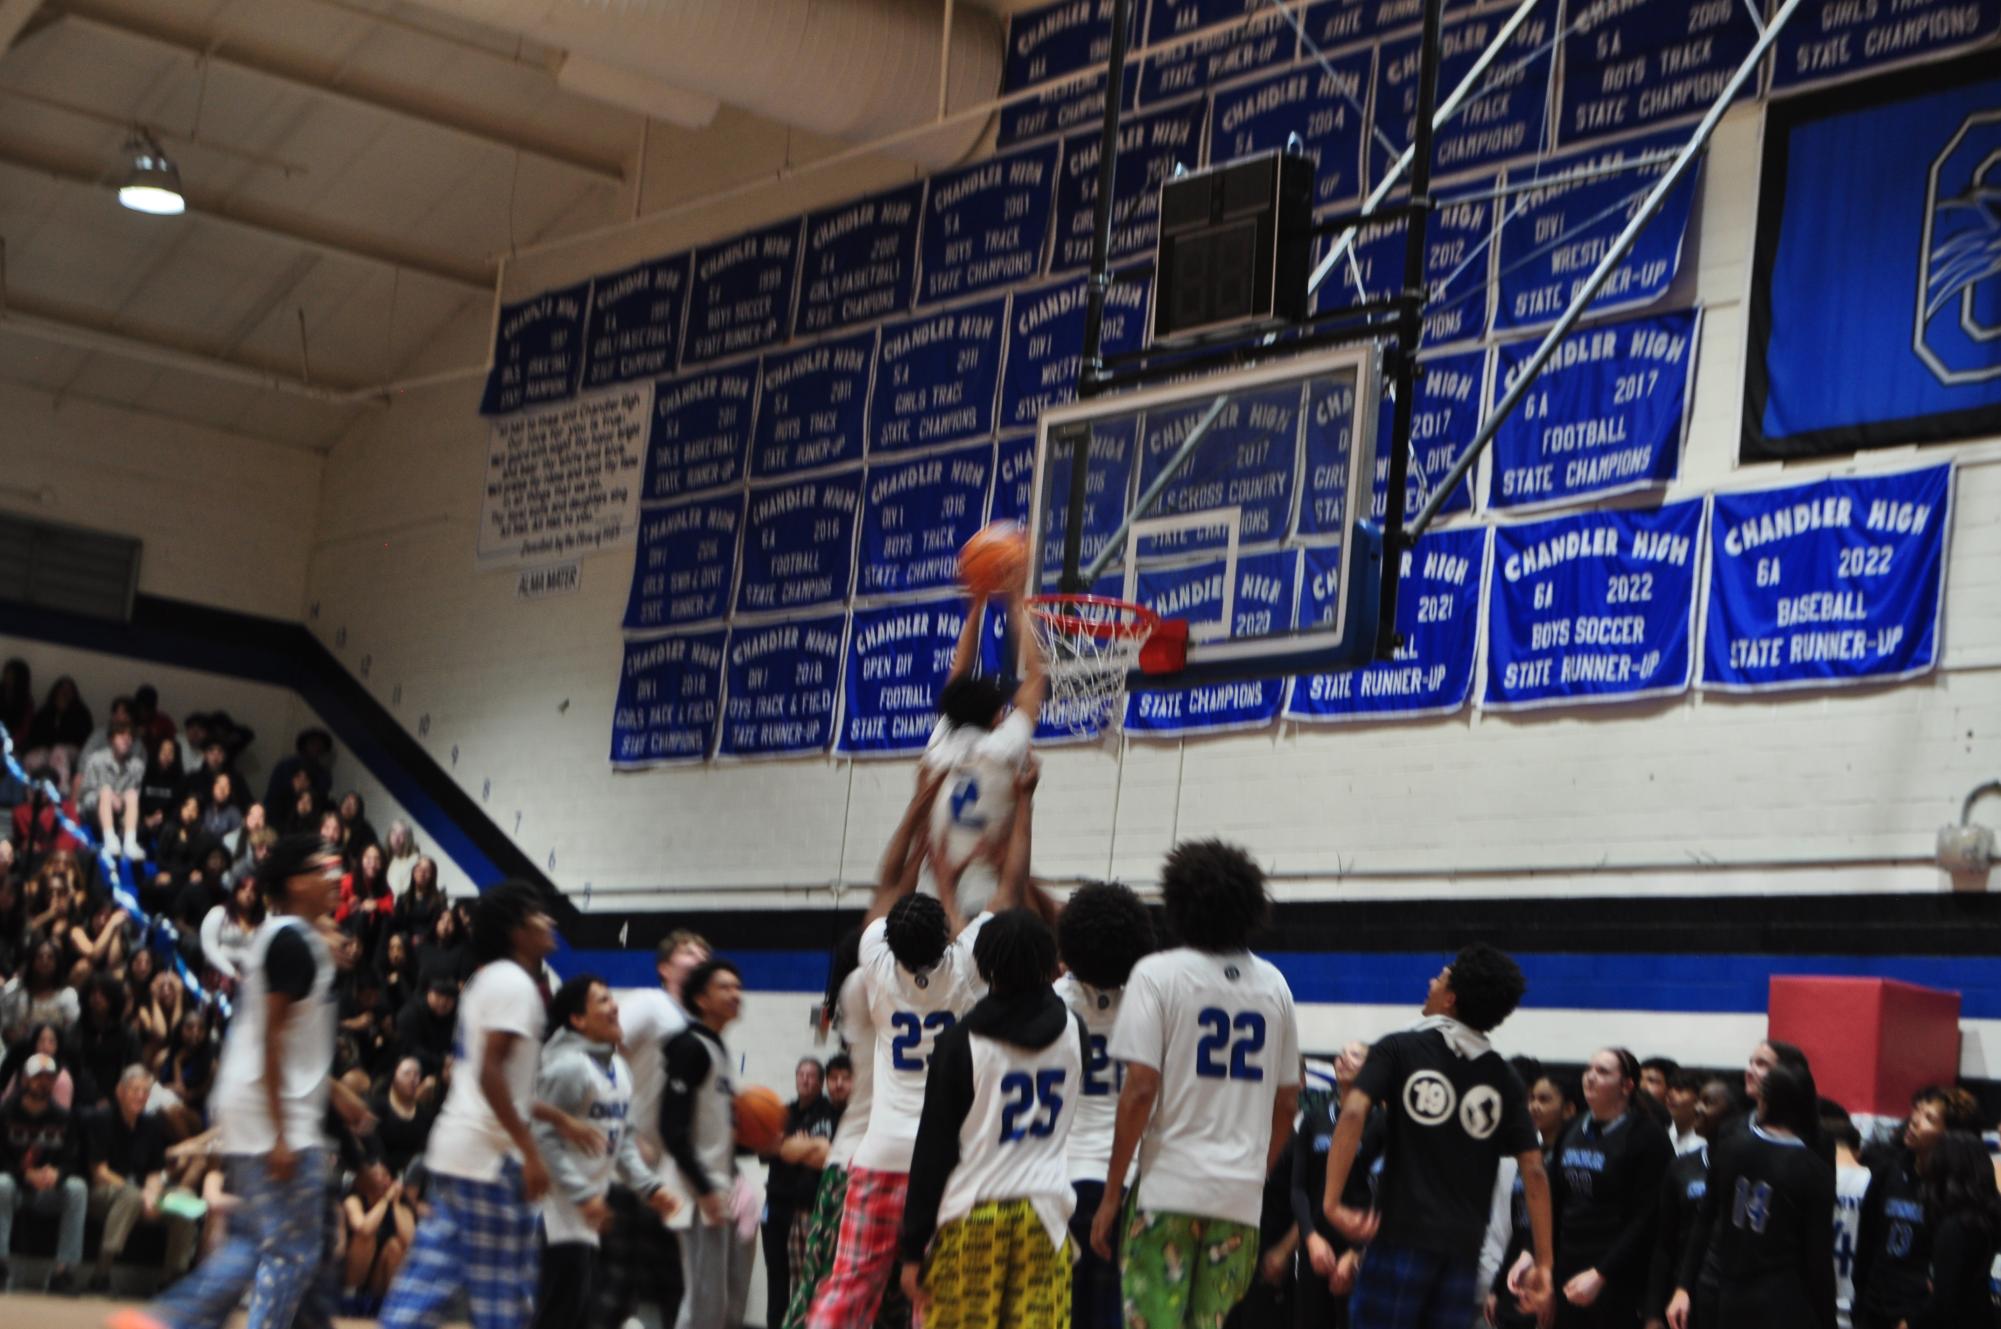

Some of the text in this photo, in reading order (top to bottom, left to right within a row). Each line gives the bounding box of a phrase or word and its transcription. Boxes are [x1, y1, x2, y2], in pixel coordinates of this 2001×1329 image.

[1661, 36, 1713, 77] TRACK
[1796, 4, 1980, 74] STATE CHAMPIONS
[1222, 76, 1308, 134] CHANDLER
[1576, 94, 1629, 133] STATE
[935, 165, 1002, 213] CHANDLER
[1514, 280, 1563, 317] STATE
[884, 314, 994, 363] CHANDLER HIGH
[1629, 330, 1686, 364] HIGH
[1425, 369, 1473, 403] HIGH
[1613, 369, 1659, 405] 2017
[919, 406, 977, 440] CHAMPIONS
[1411, 407, 1452, 441] 2017
[1542, 415, 1626, 456] FOOTBALL
[1236, 439, 1270, 469] 2017
[1502, 443, 1652, 497] STATE CHAMPIONS
[871, 460, 942, 505] CHANDLER
[951, 459, 985, 489] HIGH
[1228, 471, 1287, 504] COUNTRY
[883, 524, 956, 559] BOYS TRACK
[1724, 497, 1931, 557] CHANDLER HIGH
[864, 554, 961, 587] STATE CHAMPION
[1423, 551, 1469, 586] HIGH
[1504, 527, 1689, 583] CHANDLER HIGH
[1756, 545, 1893, 588] 6A 2022
[1241, 573, 1281, 604] HIGH
[1606, 571, 1653, 604] 2022
[1417, 593, 1453, 623] 2021
[1777, 590, 1867, 627] BASEBALL
[732, 627, 799, 665] CHANDLER
[856, 612, 929, 656] CHANDLER
[1531, 614, 1645, 651] BOYS SOCCER
[1729, 625, 1904, 669] STATE RUNNER-UP
[863, 655, 892, 681] OPEN
[895, 652, 913, 677] DIV
[1310, 663, 1447, 701] STATE RUNNER-UP
[1503, 650, 1660, 690] STATE RUNNER-UP
[879, 683, 933, 711] FOOTBALL
[1139, 680, 1263, 719] STATE CHAMPIONS
[760, 720, 820, 747] RUNNER-UP
[850, 716, 887, 742] STATE
[1196, 1006, 1267, 1084] 22
[999, 1068, 1067, 1148] 25
